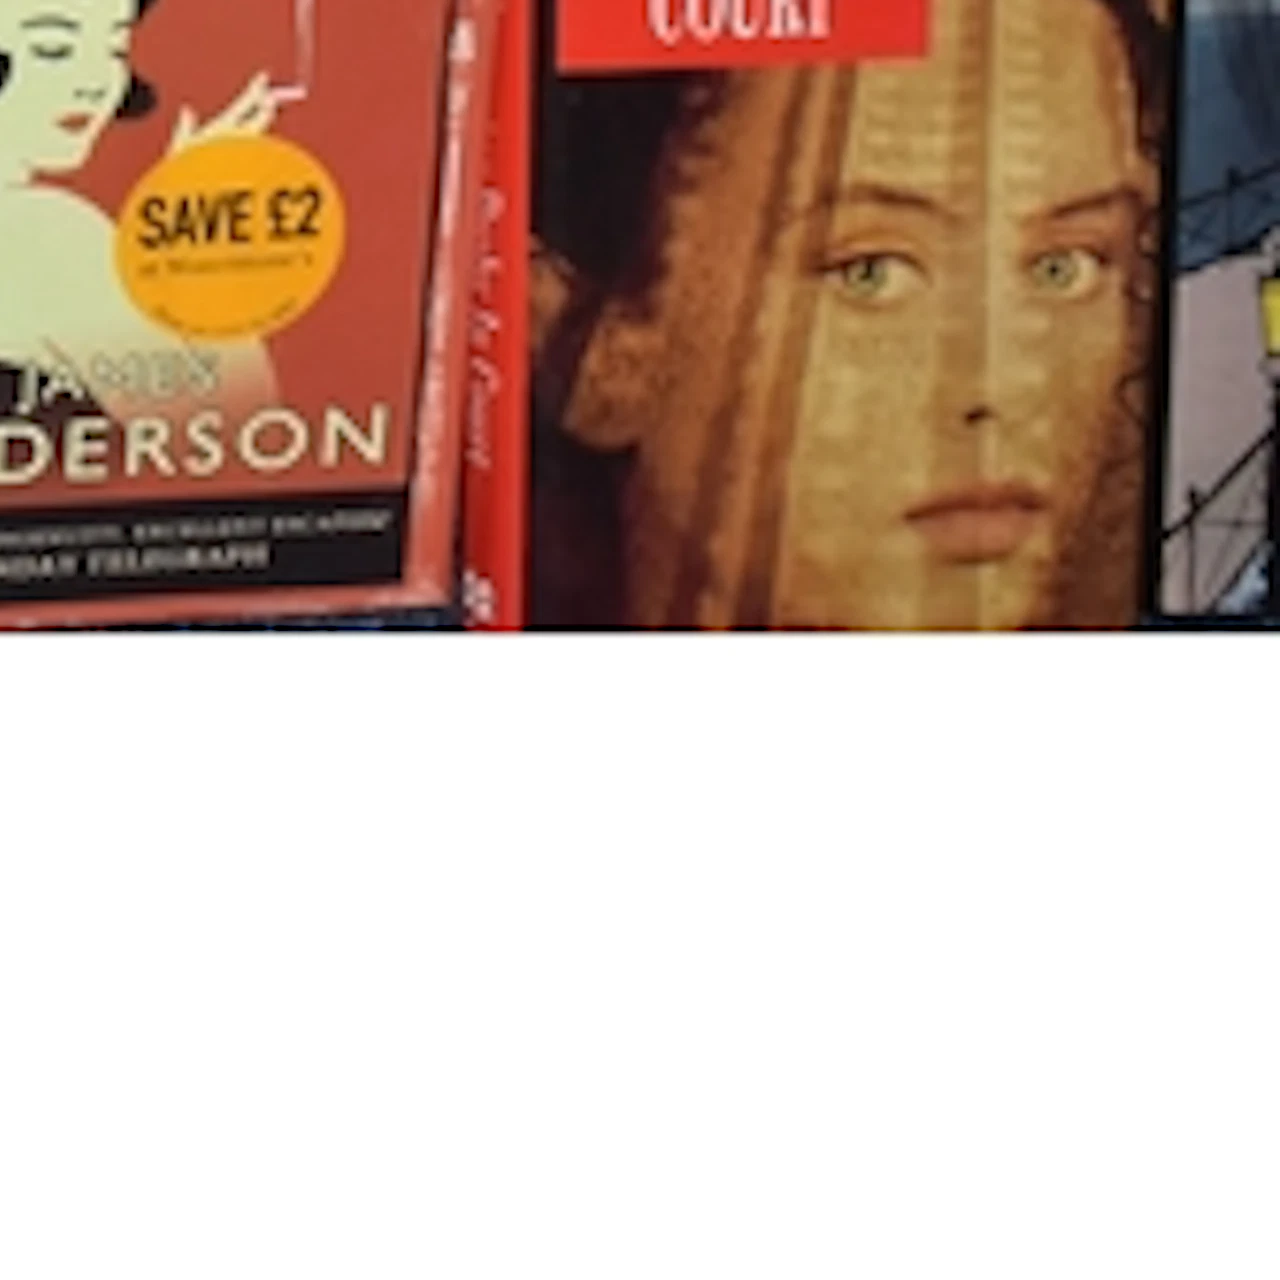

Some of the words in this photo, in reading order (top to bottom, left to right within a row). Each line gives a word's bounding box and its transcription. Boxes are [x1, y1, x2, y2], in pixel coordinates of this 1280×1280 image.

[137, 191, 254, 251] SAVE
[266, 183, 324, 239] £2
[86, 541, 271, 580] TELEGRAPH
